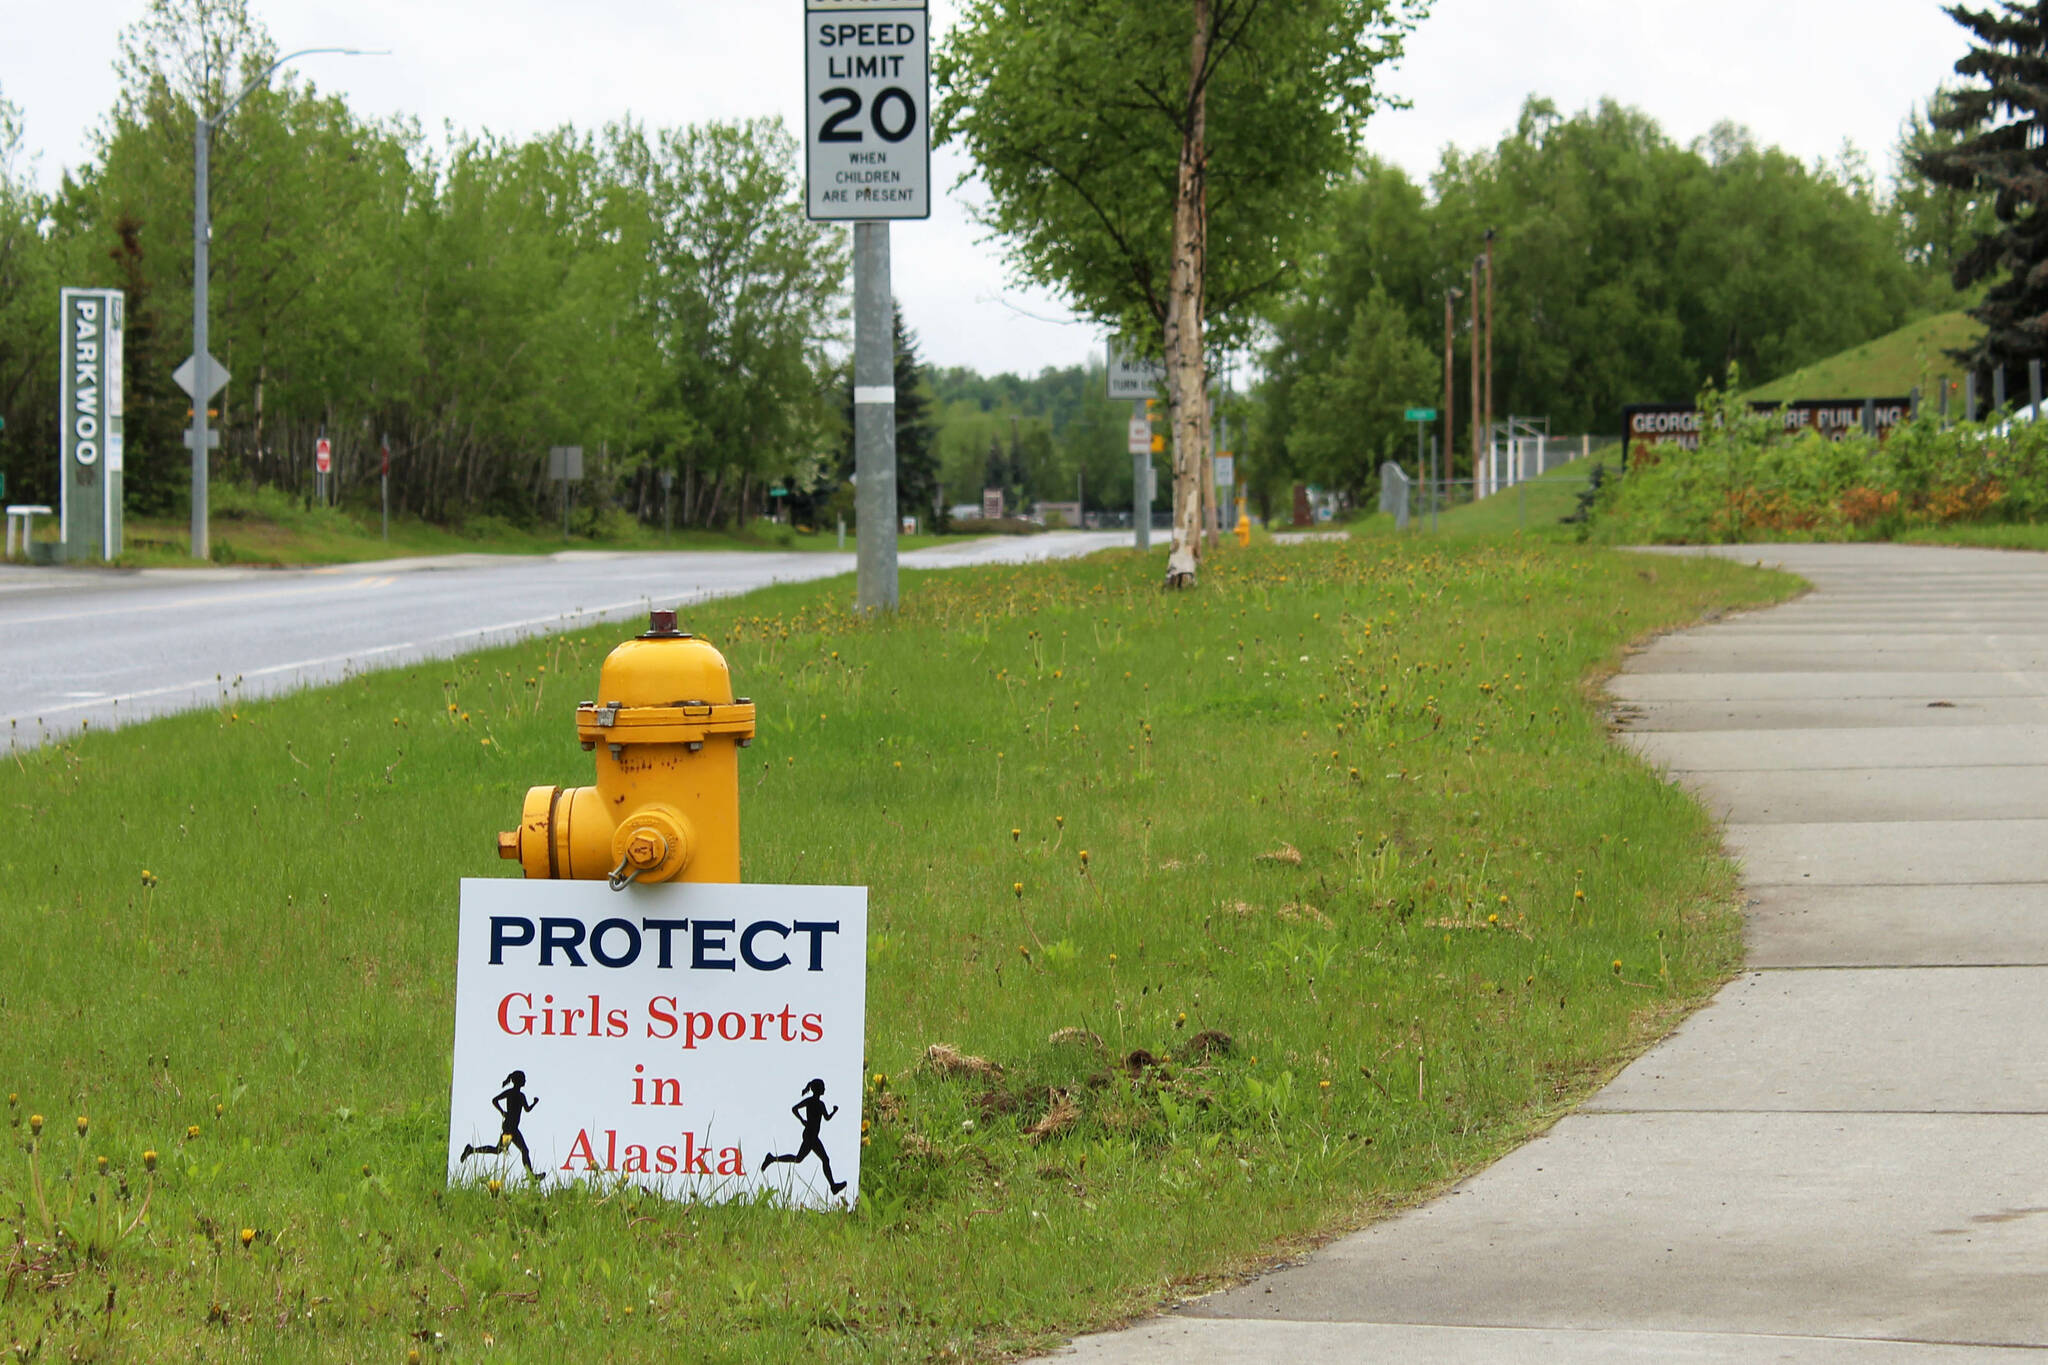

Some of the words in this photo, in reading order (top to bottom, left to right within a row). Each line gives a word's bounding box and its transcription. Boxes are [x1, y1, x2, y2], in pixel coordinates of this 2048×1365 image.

[818, 23, 915, 47] SPEED
[828, 55, 905, 79] LIMIT
[817, 86, 917, 144] 20
[849, 152, 887, 165] WHEN
[835, 170, 900, 184] CHILDREN
[822, 189, 848, 203] ARE
[855, 188, 914, 202] PRESENT
[1632, 412, 1704, 433] GEORGE
[488, 916, 840, 972] PROTECT
[498, 992, 629, 1038] Girls
[647, 995, 824, 1049] Sports
[631, 1063, 683, 1106] in
[560, 1128, 746, 1177] Alaska
